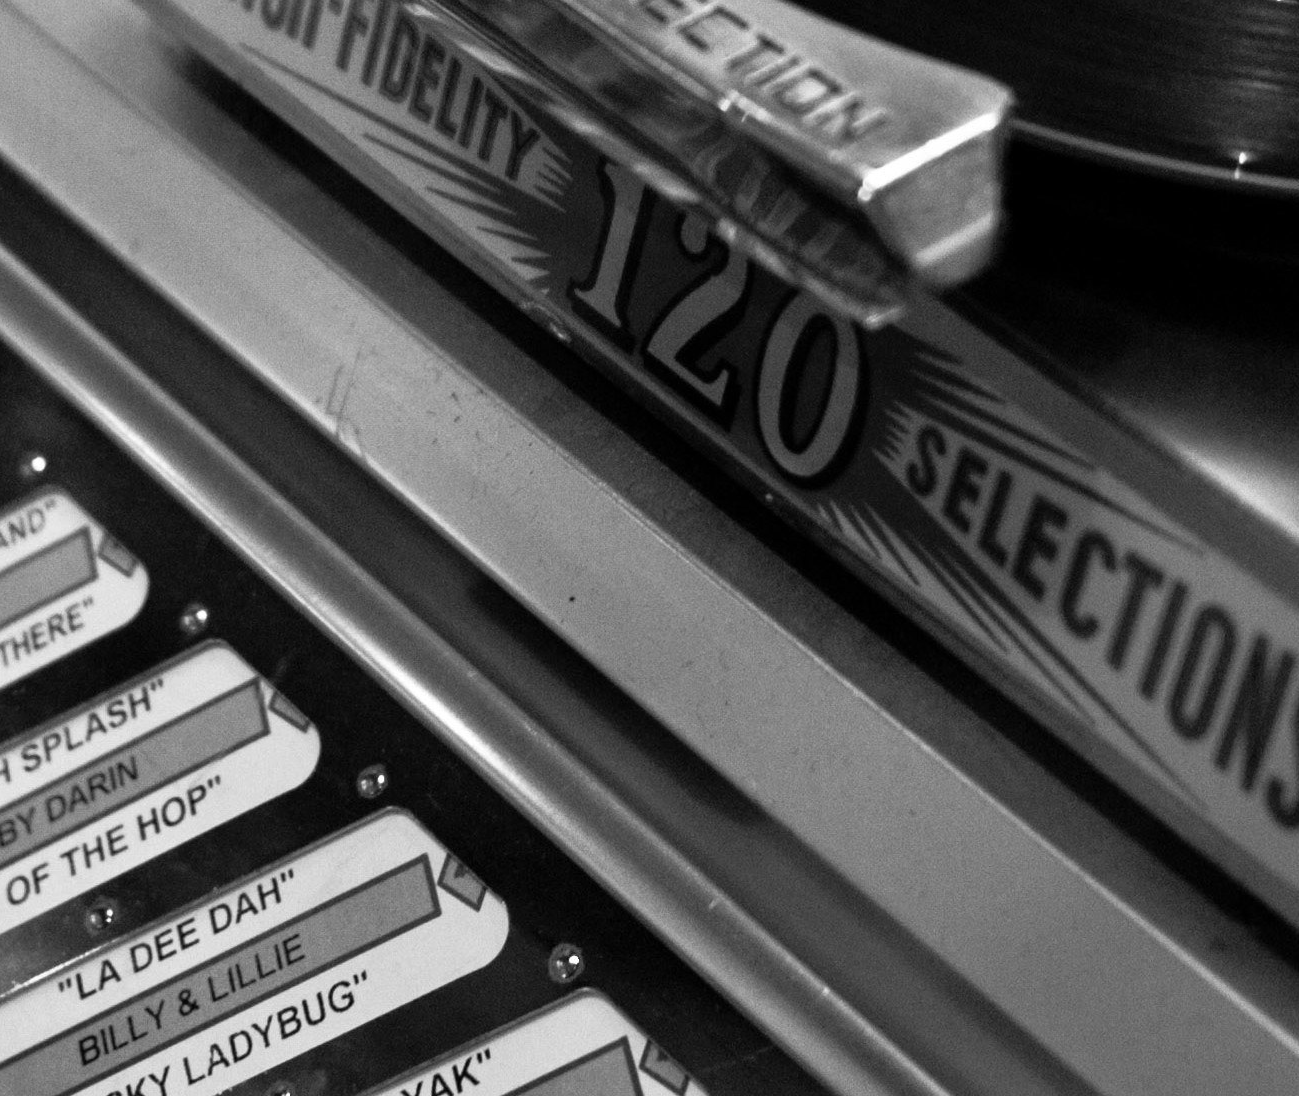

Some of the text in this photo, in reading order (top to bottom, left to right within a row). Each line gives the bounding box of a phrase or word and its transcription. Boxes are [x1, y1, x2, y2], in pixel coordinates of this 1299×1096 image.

[569, 159, 869, 488] 120
[20, 678, 165, 773] SPLASH"
[46, 756, 140, 824] DARIN
[5, 862, 51, 906] OF
[59, 823, 129, 878] THE
[136, 774, 222, 842] HOP"
[57, 869, 296, 1001] "LA DEE DAH"
[77, 933, 306, 1067] BILLY & LILLIE
[183, 970, 369, 1086] LADYBUG"
